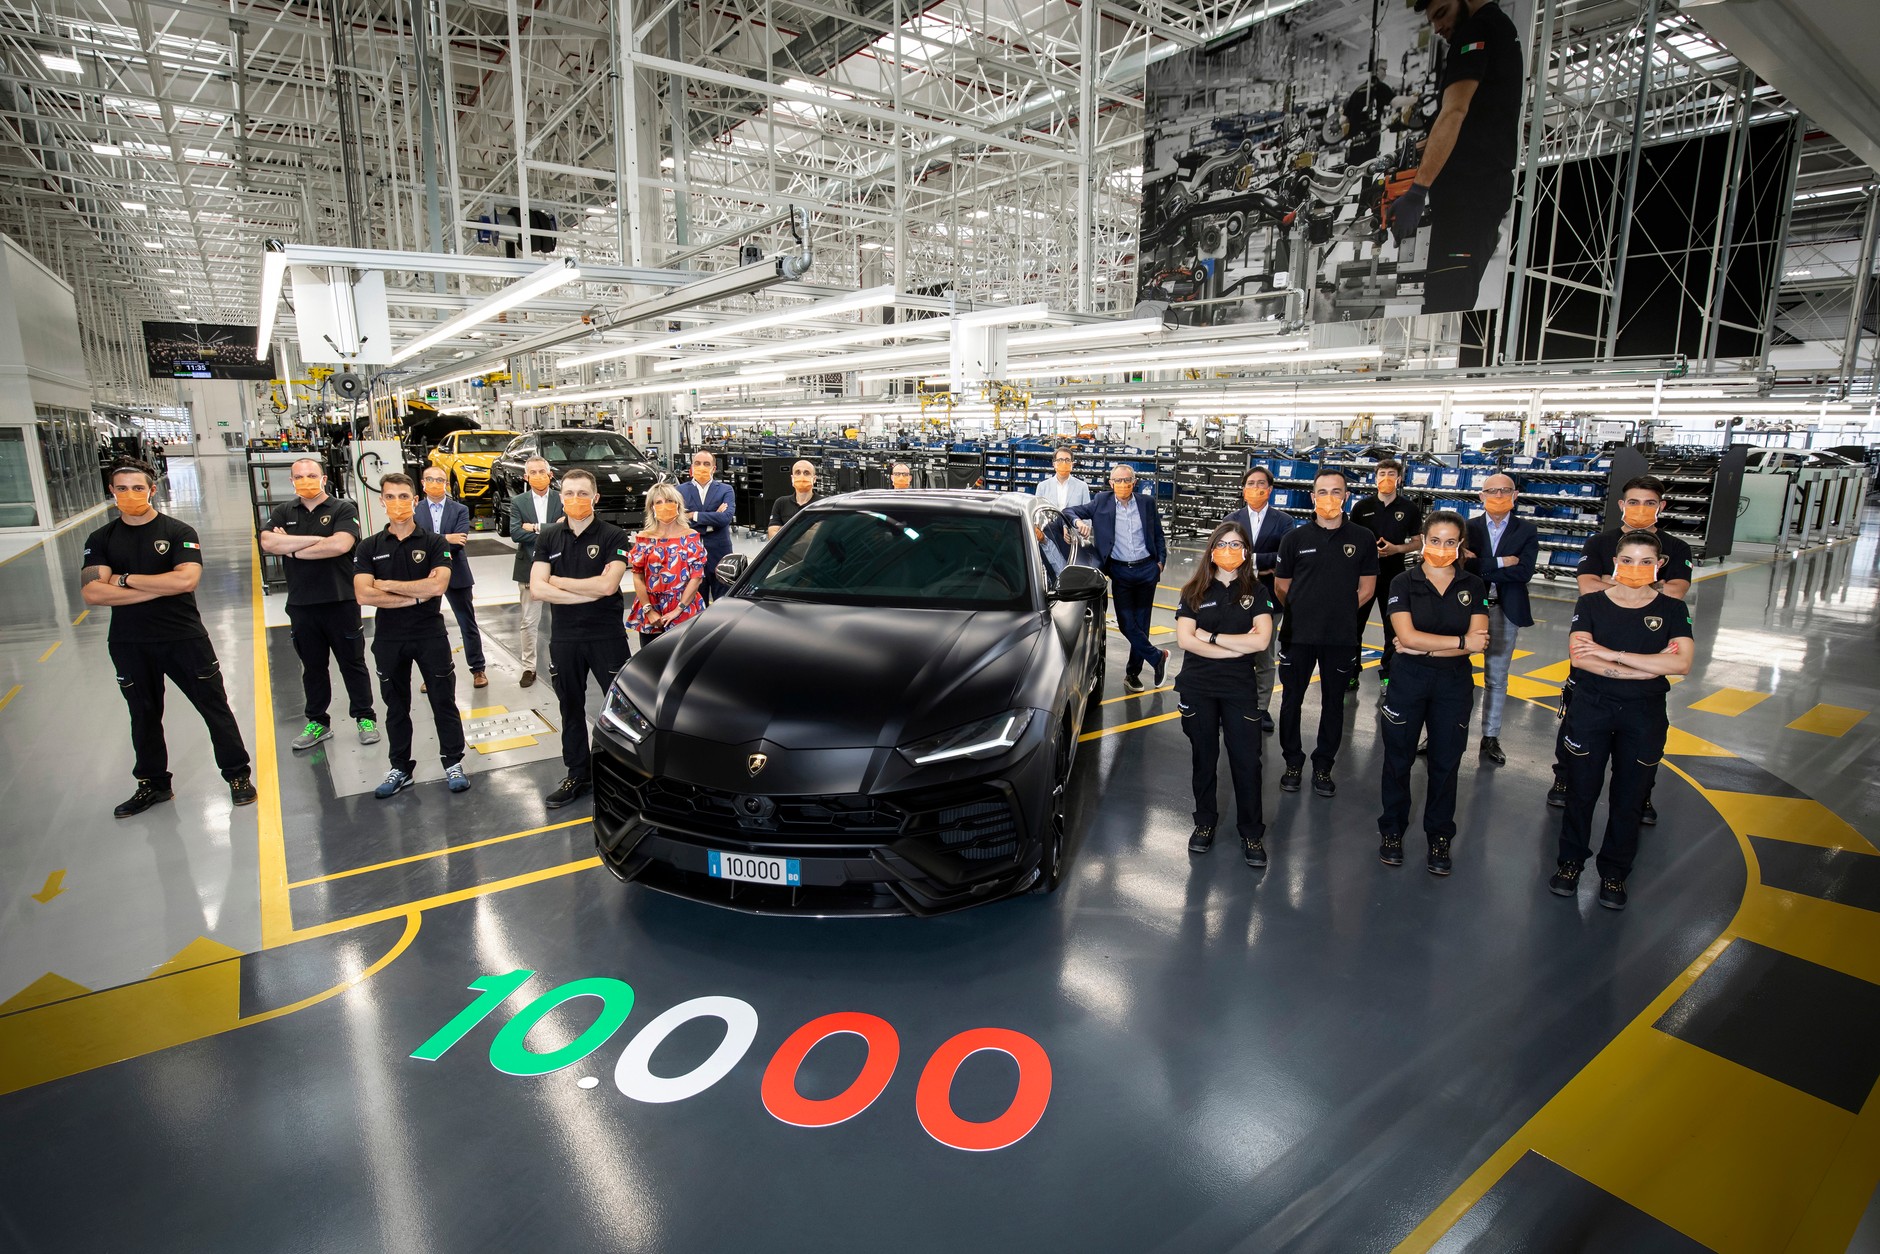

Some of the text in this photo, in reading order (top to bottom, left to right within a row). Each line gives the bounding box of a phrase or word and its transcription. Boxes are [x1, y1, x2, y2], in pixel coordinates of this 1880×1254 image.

[727, 857, 780, 880] 10.000
[788, 873, 798, 882] BO
[409, 969, 1052, 1152] 10.000
